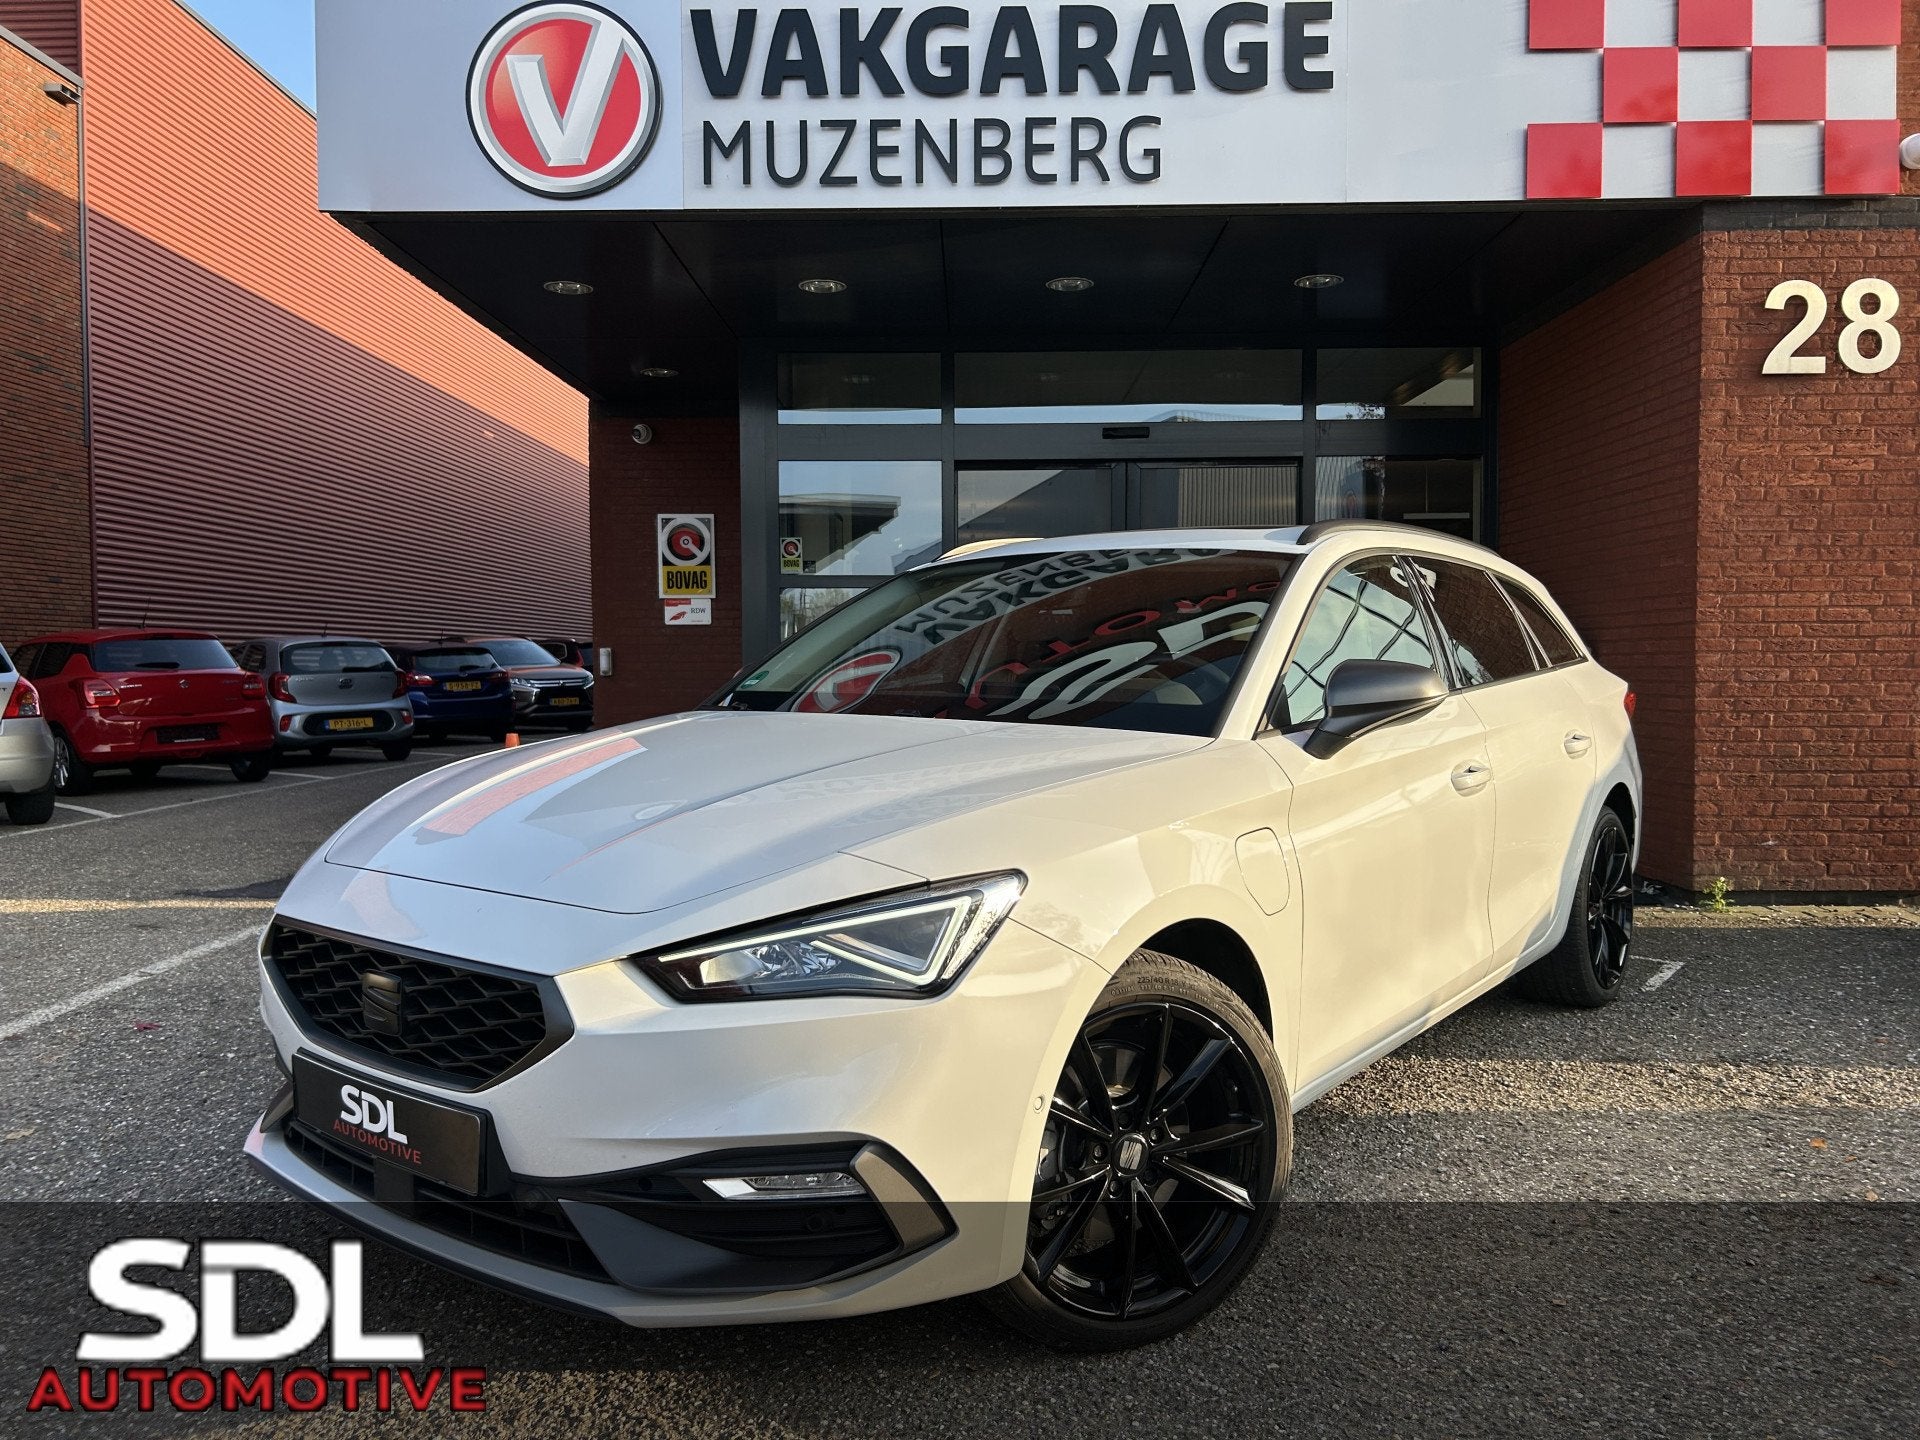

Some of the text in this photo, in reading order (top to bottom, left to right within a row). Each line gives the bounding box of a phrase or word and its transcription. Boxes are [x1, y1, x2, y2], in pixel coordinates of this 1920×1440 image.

[690, 1, 1334, 98] VAKGARAGE
[703, 115, 1161, 187] MUZENBERG
[1762, 278, 1901, 375] 28
[667, 570, 707, 590] BOVAG
[783, 559, 800, 568] BOVAG
[333, 1119, 422, 1165] AUTOMOTIVE
[340, 1084, 408, 1145] SDL
